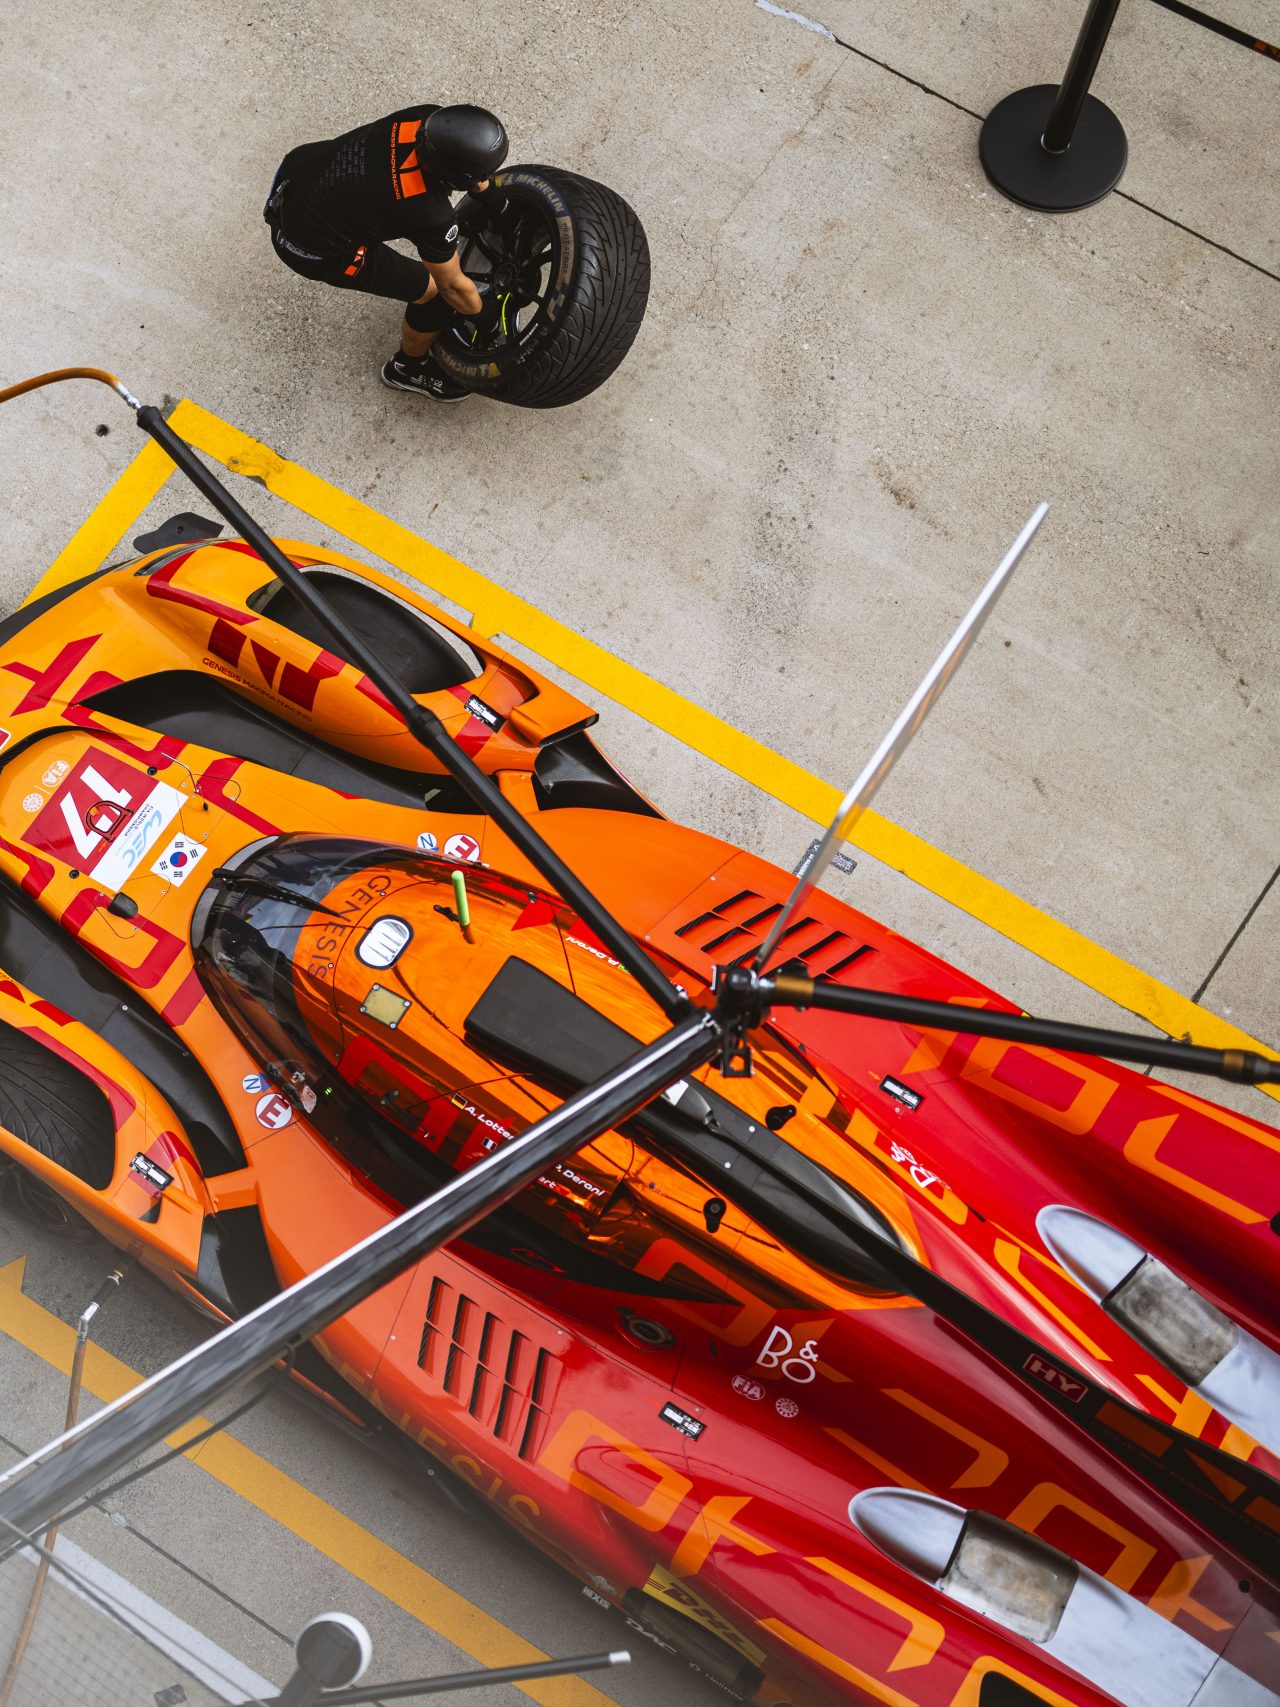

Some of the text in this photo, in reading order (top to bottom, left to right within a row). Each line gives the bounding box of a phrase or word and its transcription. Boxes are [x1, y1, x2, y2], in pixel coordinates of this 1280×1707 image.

[515, 173, 565, 213] MICHELIN
[202, 657, 241, 682] GENESIS
[43, 761, 69, 785] FIA
[60, 765, 133, 860] 17
[124, 803, 150, 836] CHAMPIONSHIP
[122, 809, 162, 869] WEC
[307, 875, 392, 979] GENESIS
[565, 936, 607, 959] Derani
[465, 1106, 515, 1141] A. Lotter
[562, 1169, 606, 1197] Derani
[755, 1325, 819, 1384] B&O
[732, 1375, 762, 1399] FIA
[1029, 1359, 1082, 1393] HY
[663, 1581, 744, 1644] DHL
